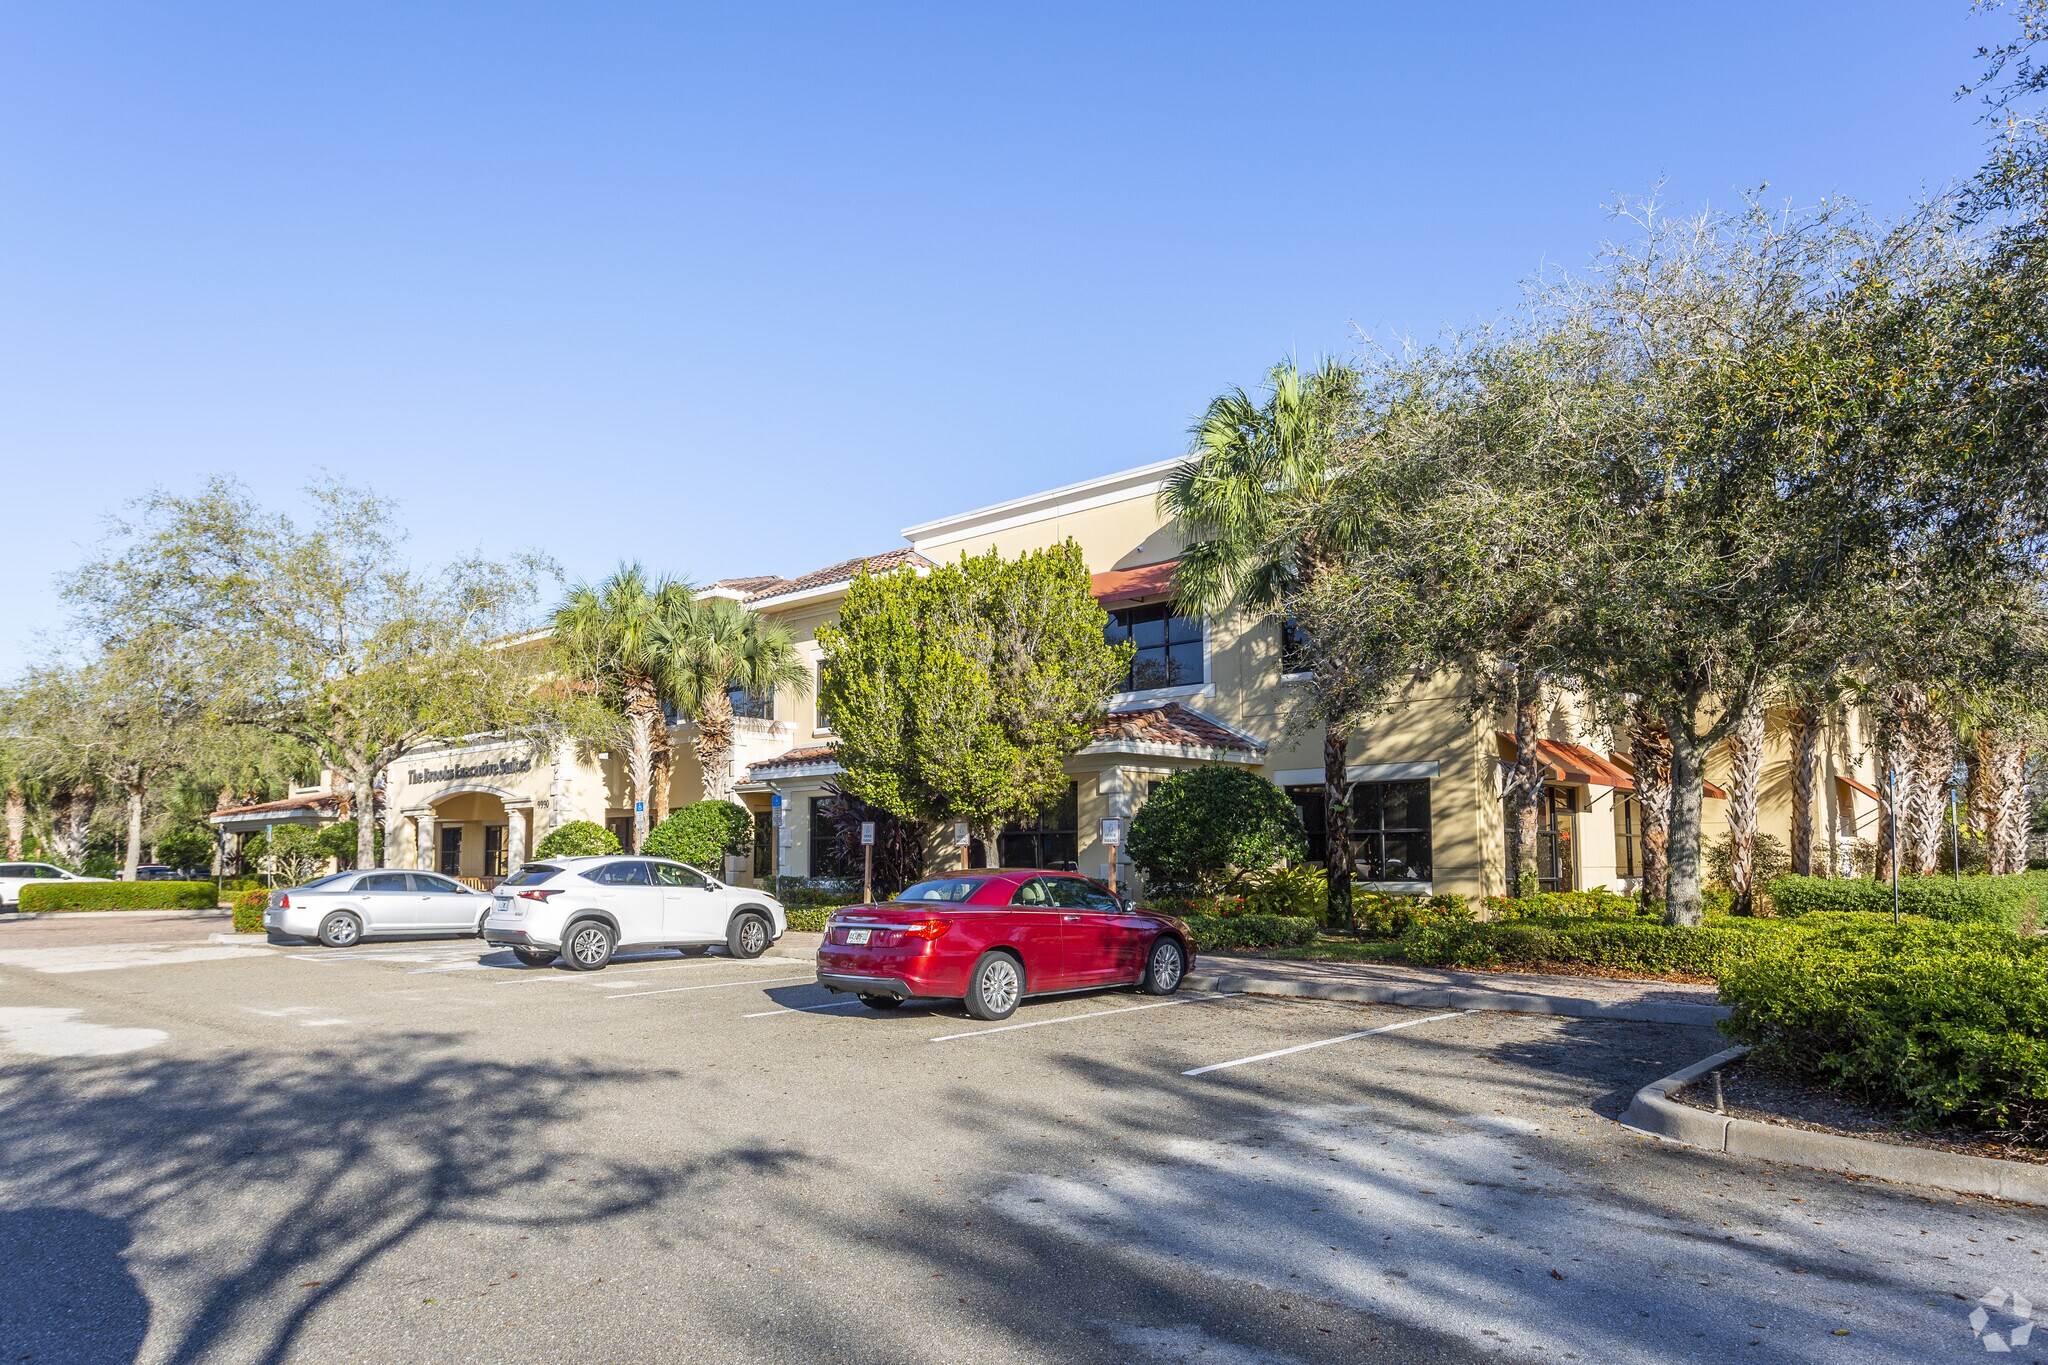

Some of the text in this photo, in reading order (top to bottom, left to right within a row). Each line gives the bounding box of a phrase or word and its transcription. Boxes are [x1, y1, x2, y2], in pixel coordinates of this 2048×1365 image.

[408, 757, 531, 785] The Brooks Executive Suites
[537, 800, 549, 809] 9990
